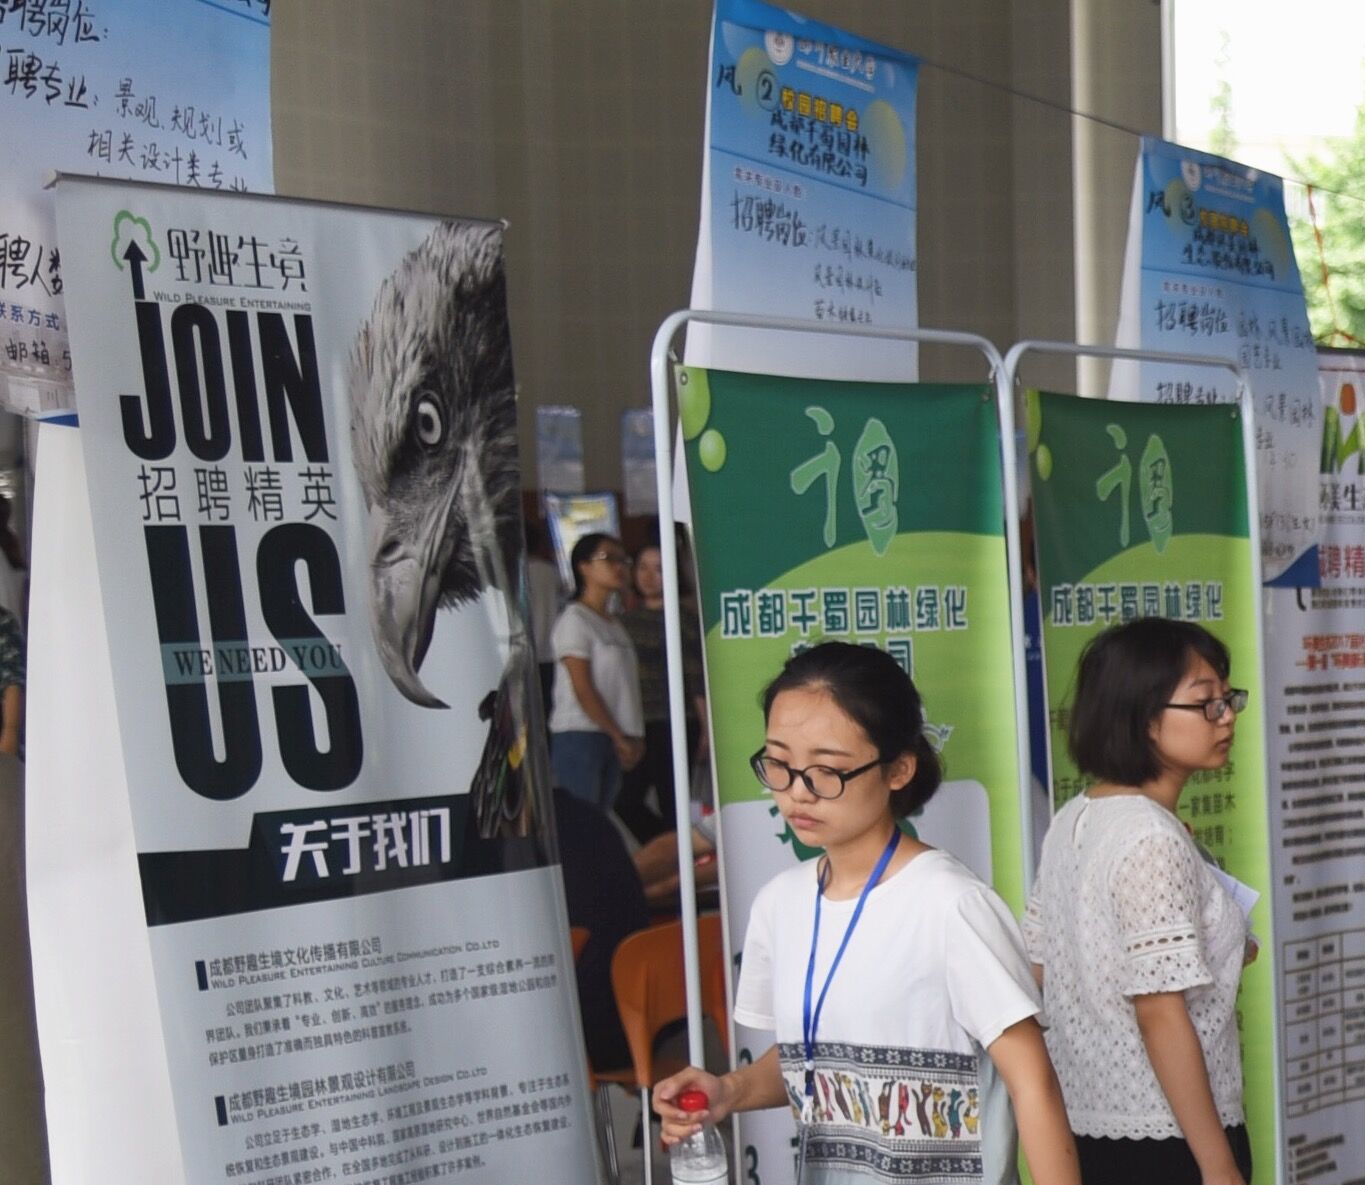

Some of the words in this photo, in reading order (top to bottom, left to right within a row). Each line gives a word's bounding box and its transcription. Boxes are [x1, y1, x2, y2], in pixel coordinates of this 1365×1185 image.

[119, 301, 330, 463] JOIN
[136, 464, 340, 524] 招聘精英
[719, 586, 968, 640] 成都千蜀园林绿化
[1050, 580, 1224, 627] 成都千蜀园林绿化
[143, 521, 364, 801] US
[172, 649, 215, 678] WE
[217, 645, 287, 676] NEED
[292, 643, 343, 672] YOU
[279, 806, 451, 883] 关于我们
